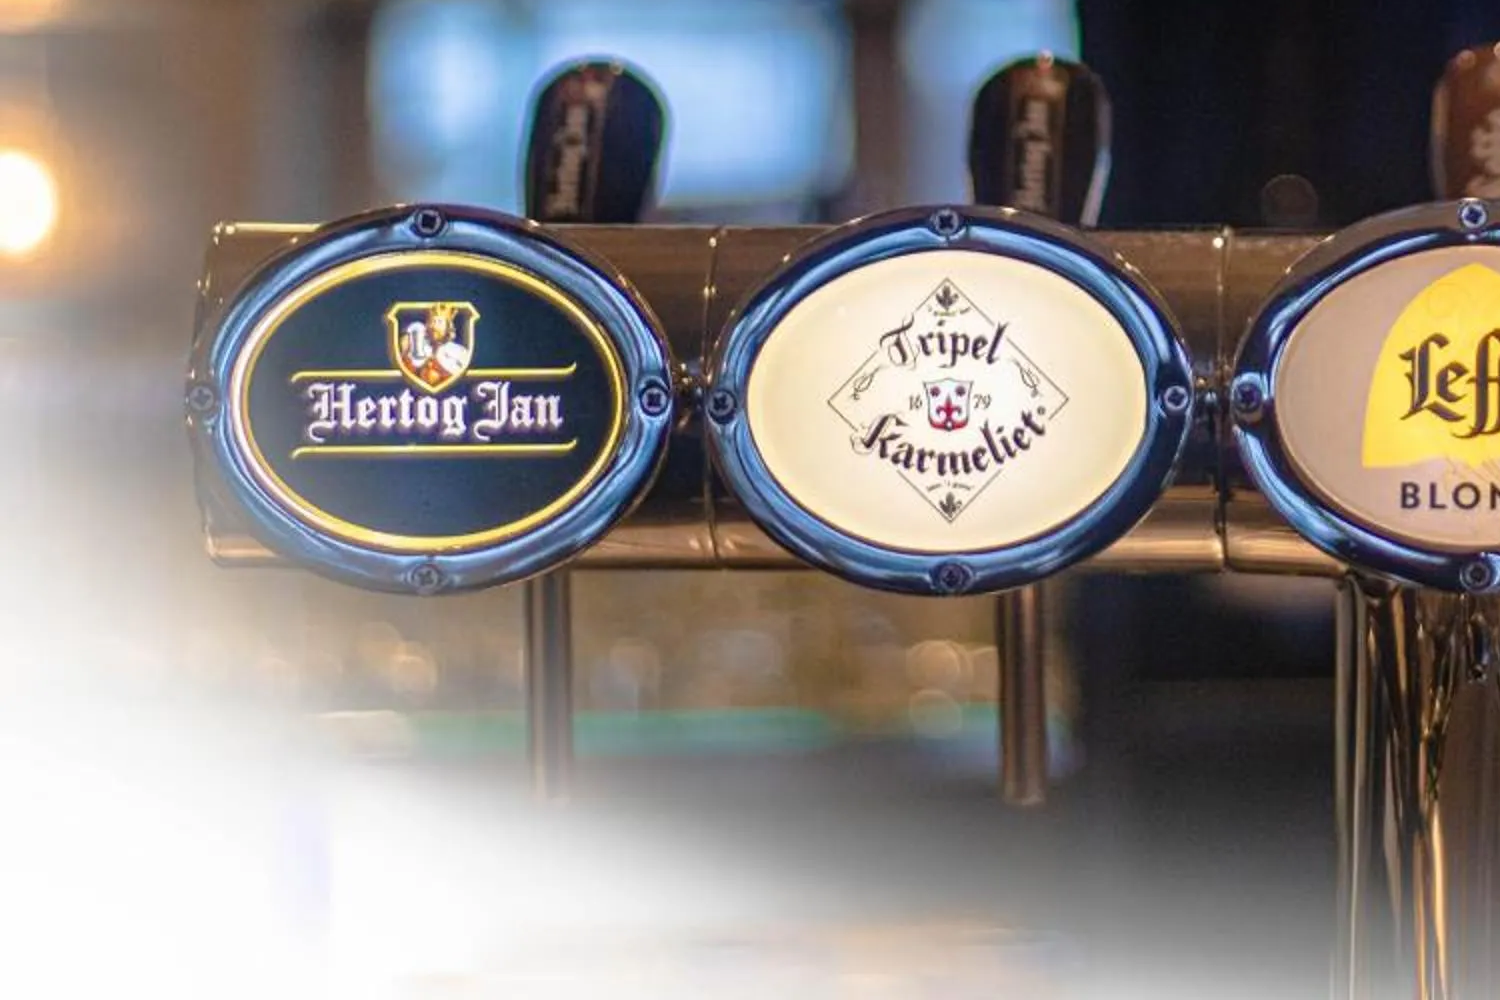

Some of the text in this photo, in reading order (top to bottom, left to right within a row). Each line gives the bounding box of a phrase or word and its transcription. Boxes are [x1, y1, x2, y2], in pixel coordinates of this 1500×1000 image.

[880, 313, 1009, 371] Tripel
[307, 381, 563, 443] Hertog Jan
